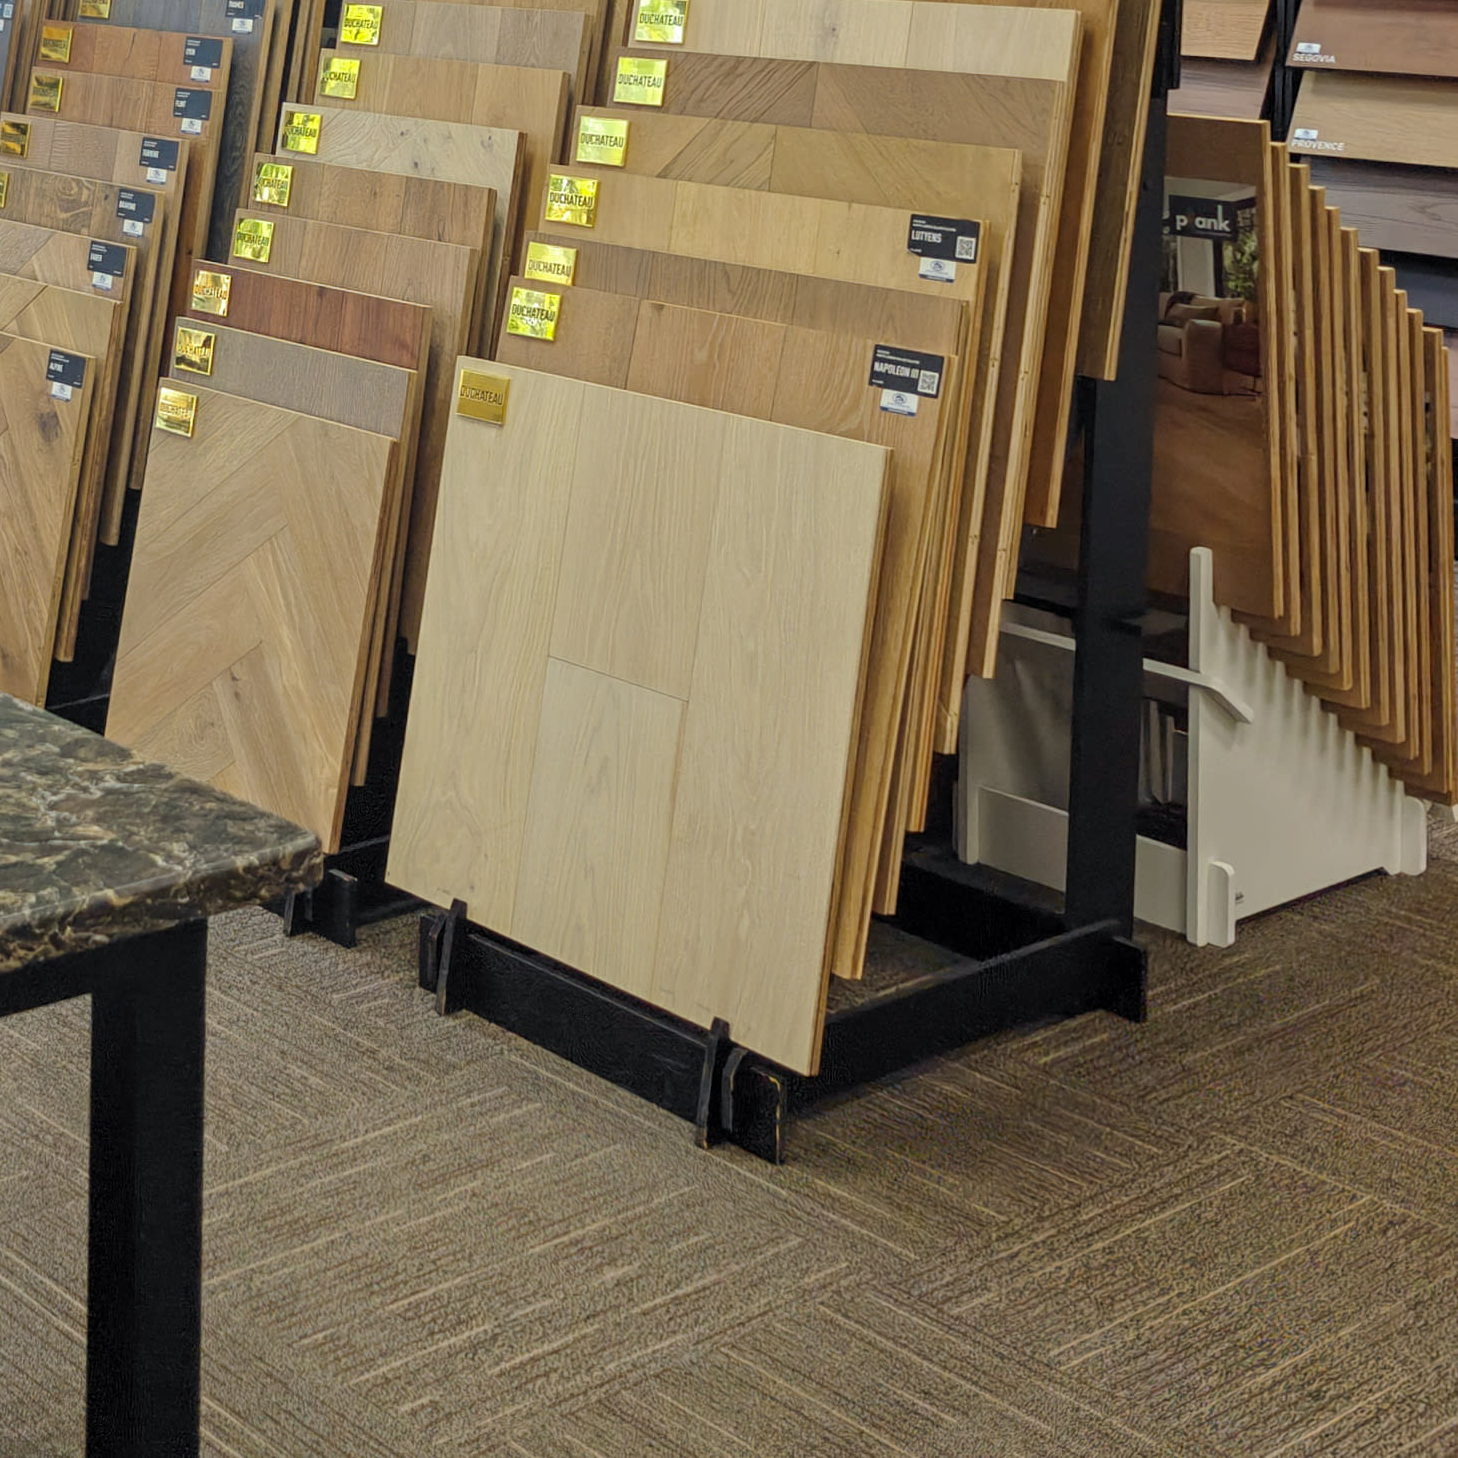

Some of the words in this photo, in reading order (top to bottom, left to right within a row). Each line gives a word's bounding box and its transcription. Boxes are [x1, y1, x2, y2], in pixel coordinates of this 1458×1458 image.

[343, 17, 379, 31] DUCHATEAU
[639, 12, 684, 27] DUCHATEAU
[617, 72, 663, 88] DUCHATEAU
[580, 132, 625, 148] DUCHATEAU
[1291, 139, 1346, 151] PROVENCE
[549, 191, 594, 209] DUCHATEAU
[910, 229, 943, 244] LUTYENS
[528, 258, 572, 278] DUCHATEAU
[511, 302, 556, 323] DUCHATEAU
[874, 360, 911, 378] NAPOLEON
[459, 384, 504, 406] DUCHATEAU
